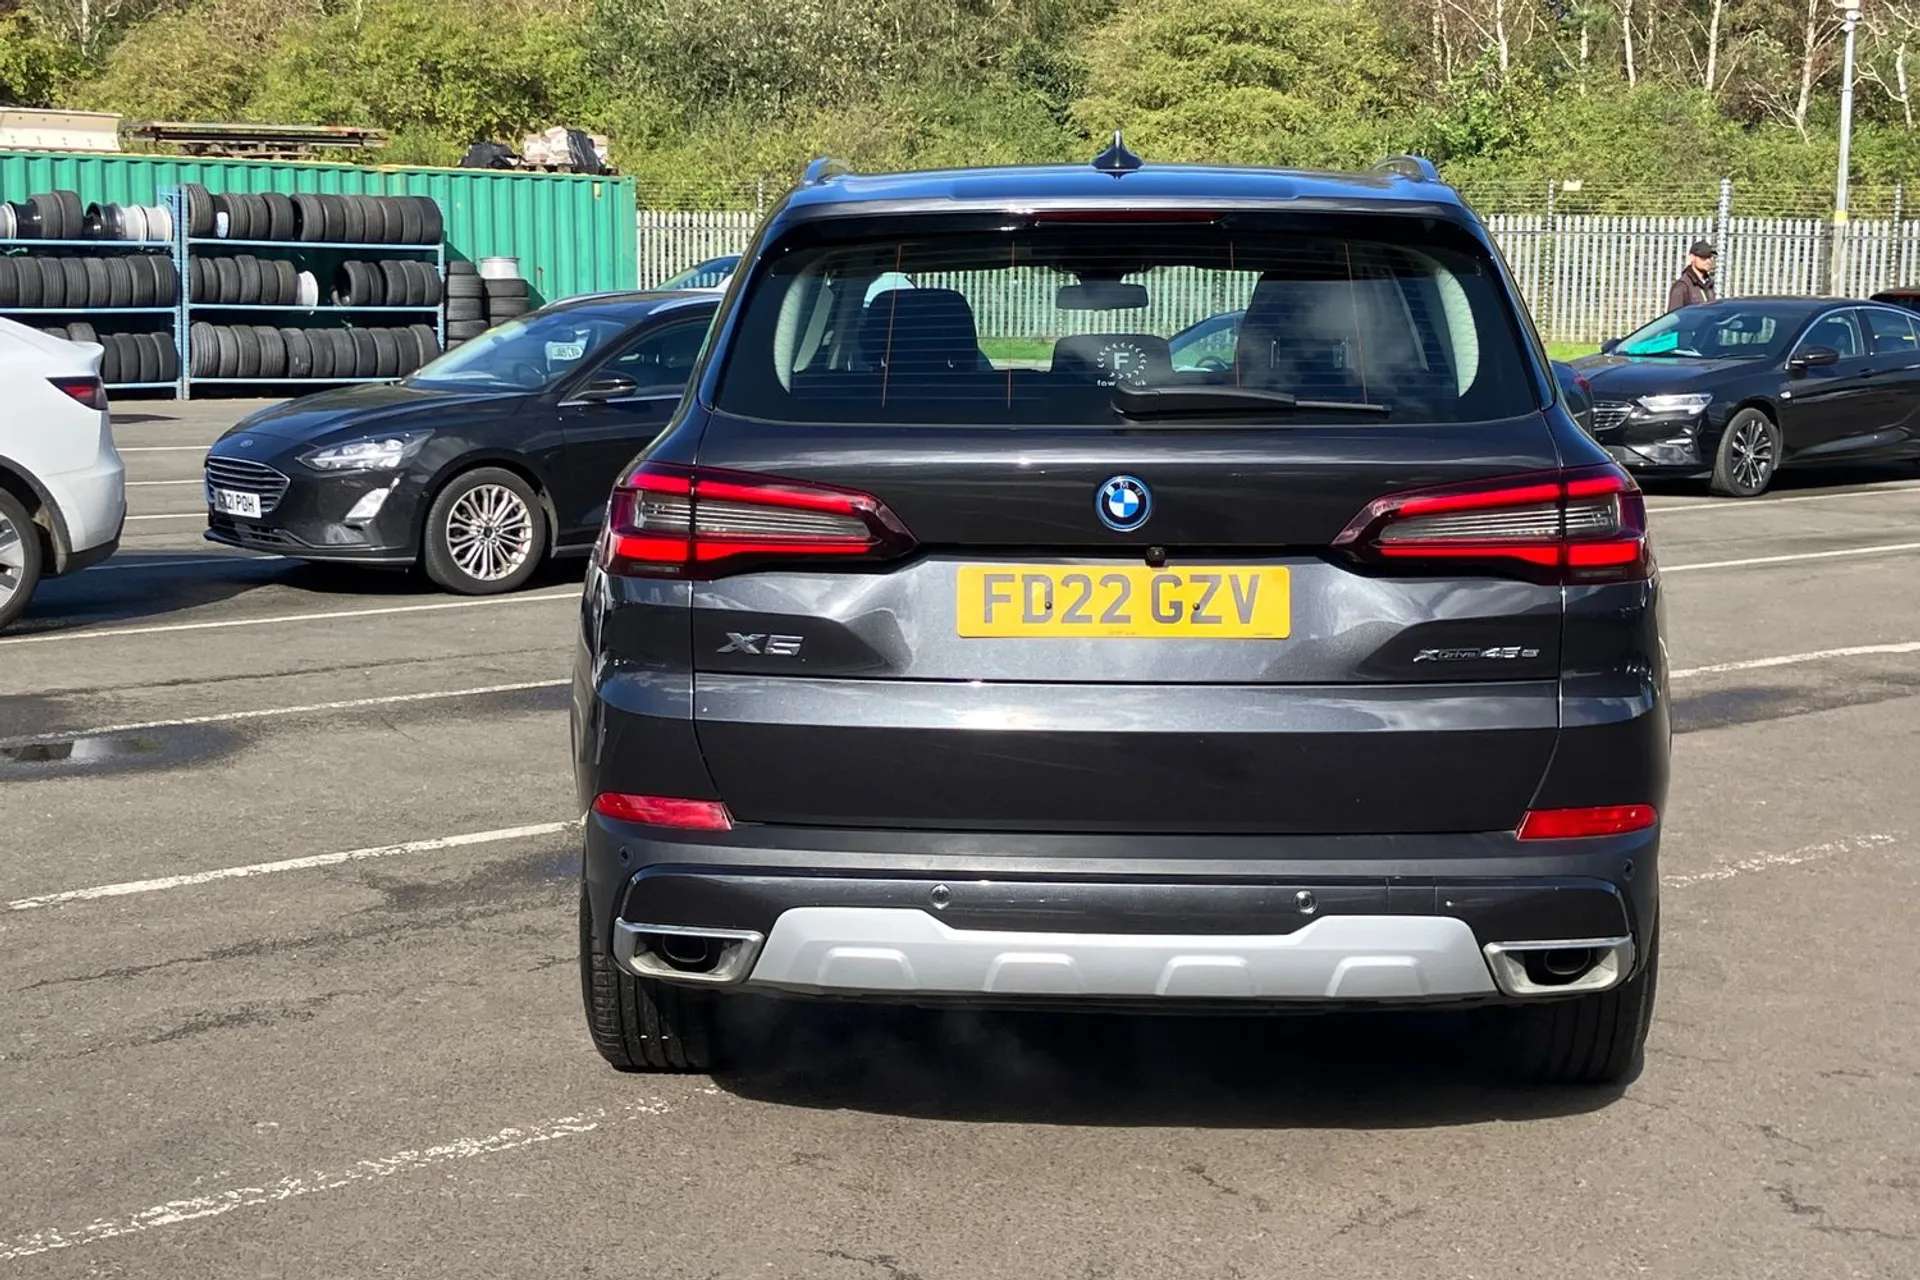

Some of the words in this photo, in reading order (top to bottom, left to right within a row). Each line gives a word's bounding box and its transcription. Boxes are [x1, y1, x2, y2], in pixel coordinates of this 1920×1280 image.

[1113, 352, 1130, 370] F
[983, 573, 1132, 625] FD22
[1150, 573, 1260, 625] GZV
[716, 632, 804, 656] X5
